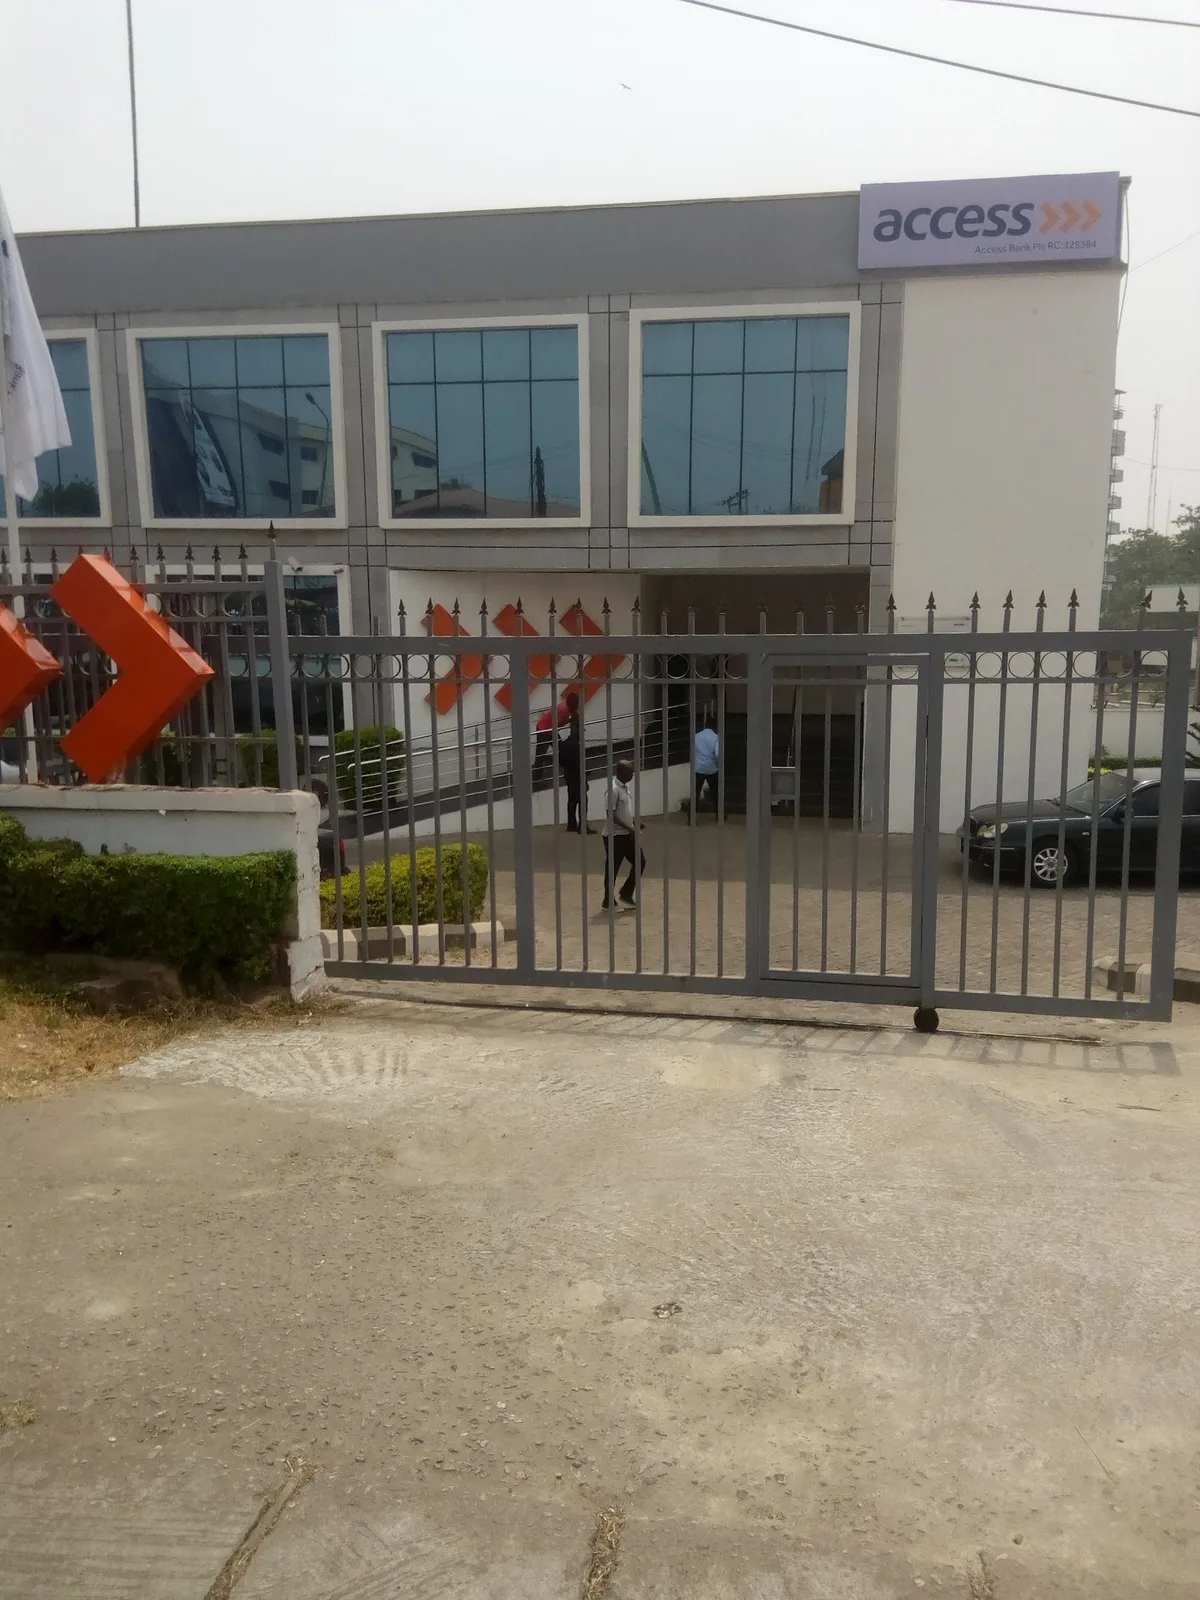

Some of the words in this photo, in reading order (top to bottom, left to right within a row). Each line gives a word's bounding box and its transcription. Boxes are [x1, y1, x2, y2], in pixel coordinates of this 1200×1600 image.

[873, 202, 1035, 242] access
[975, 245, 1007, 254] Access
[1009, 244, 1031, 253] Bank
[1033, 243, 1046, 251] Plc
